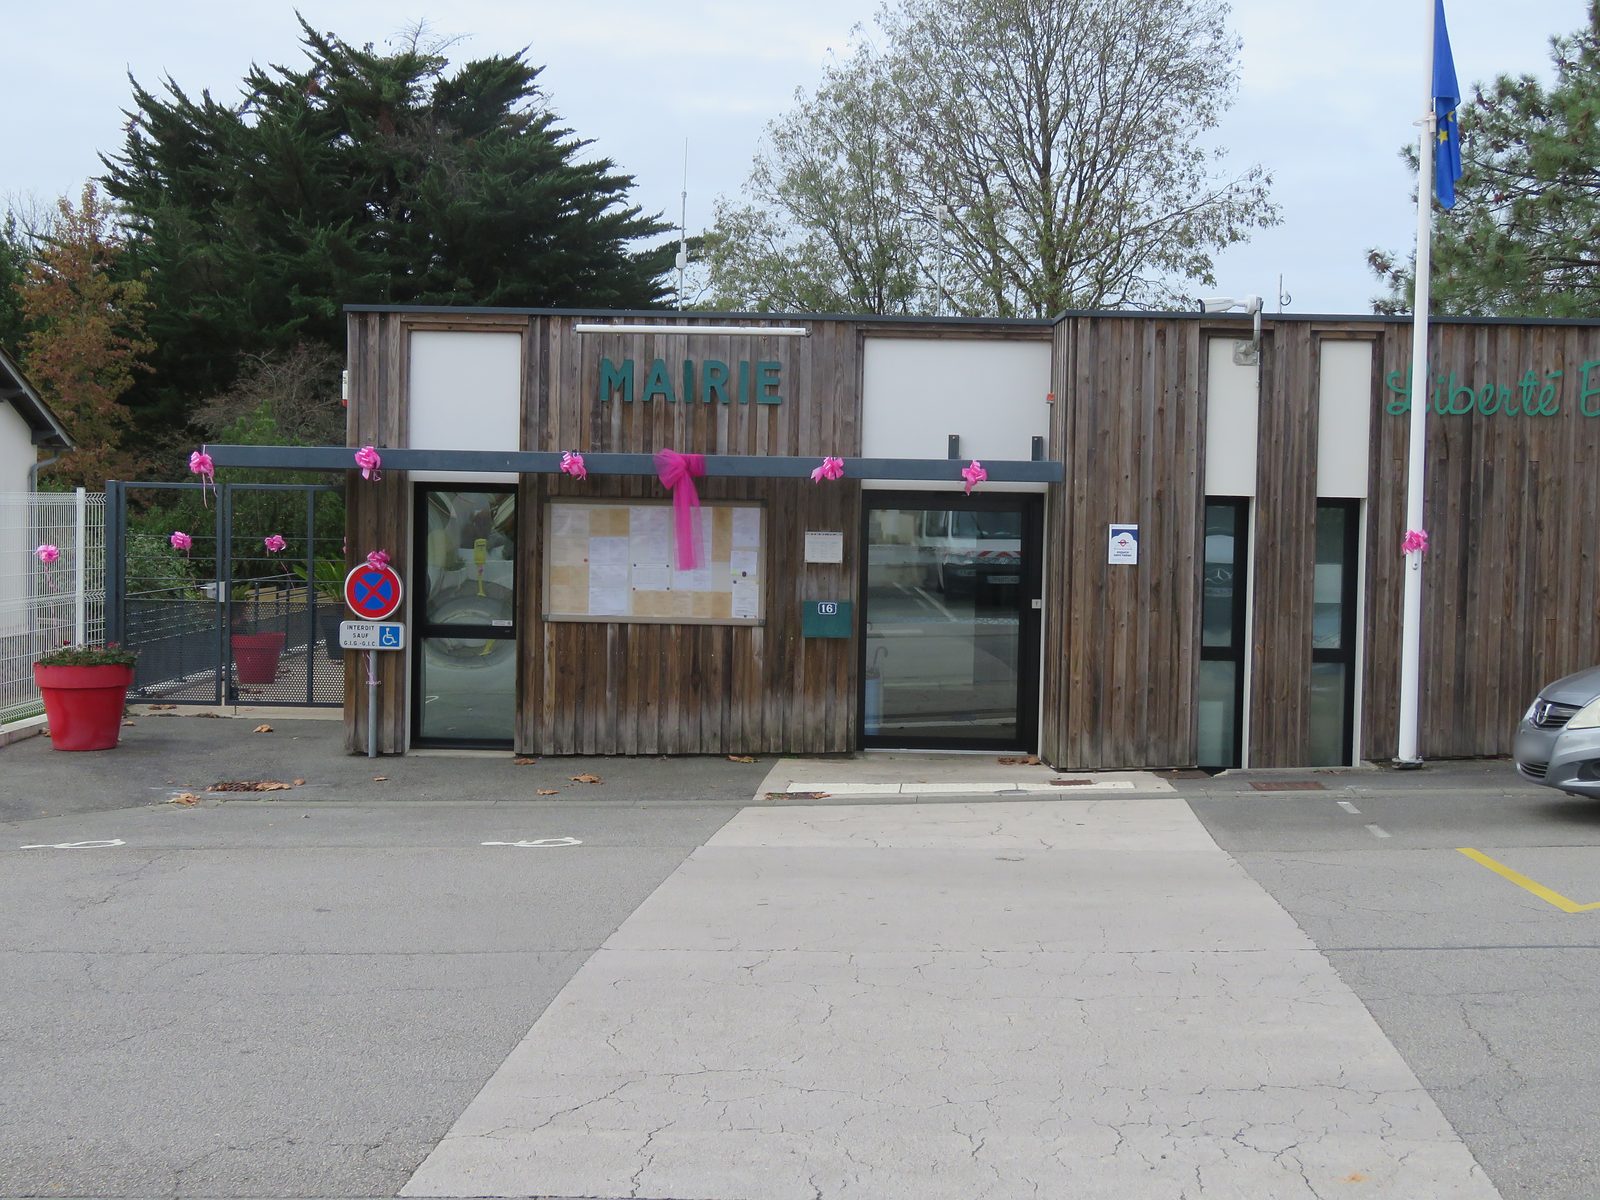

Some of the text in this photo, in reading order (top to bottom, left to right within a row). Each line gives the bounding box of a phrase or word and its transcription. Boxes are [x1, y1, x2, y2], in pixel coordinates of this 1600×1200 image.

[600, 358, 782, 405] MAIRIE
[1386, 361, 1563, 416] Liberté
[821, 604, 833, 613] 16
